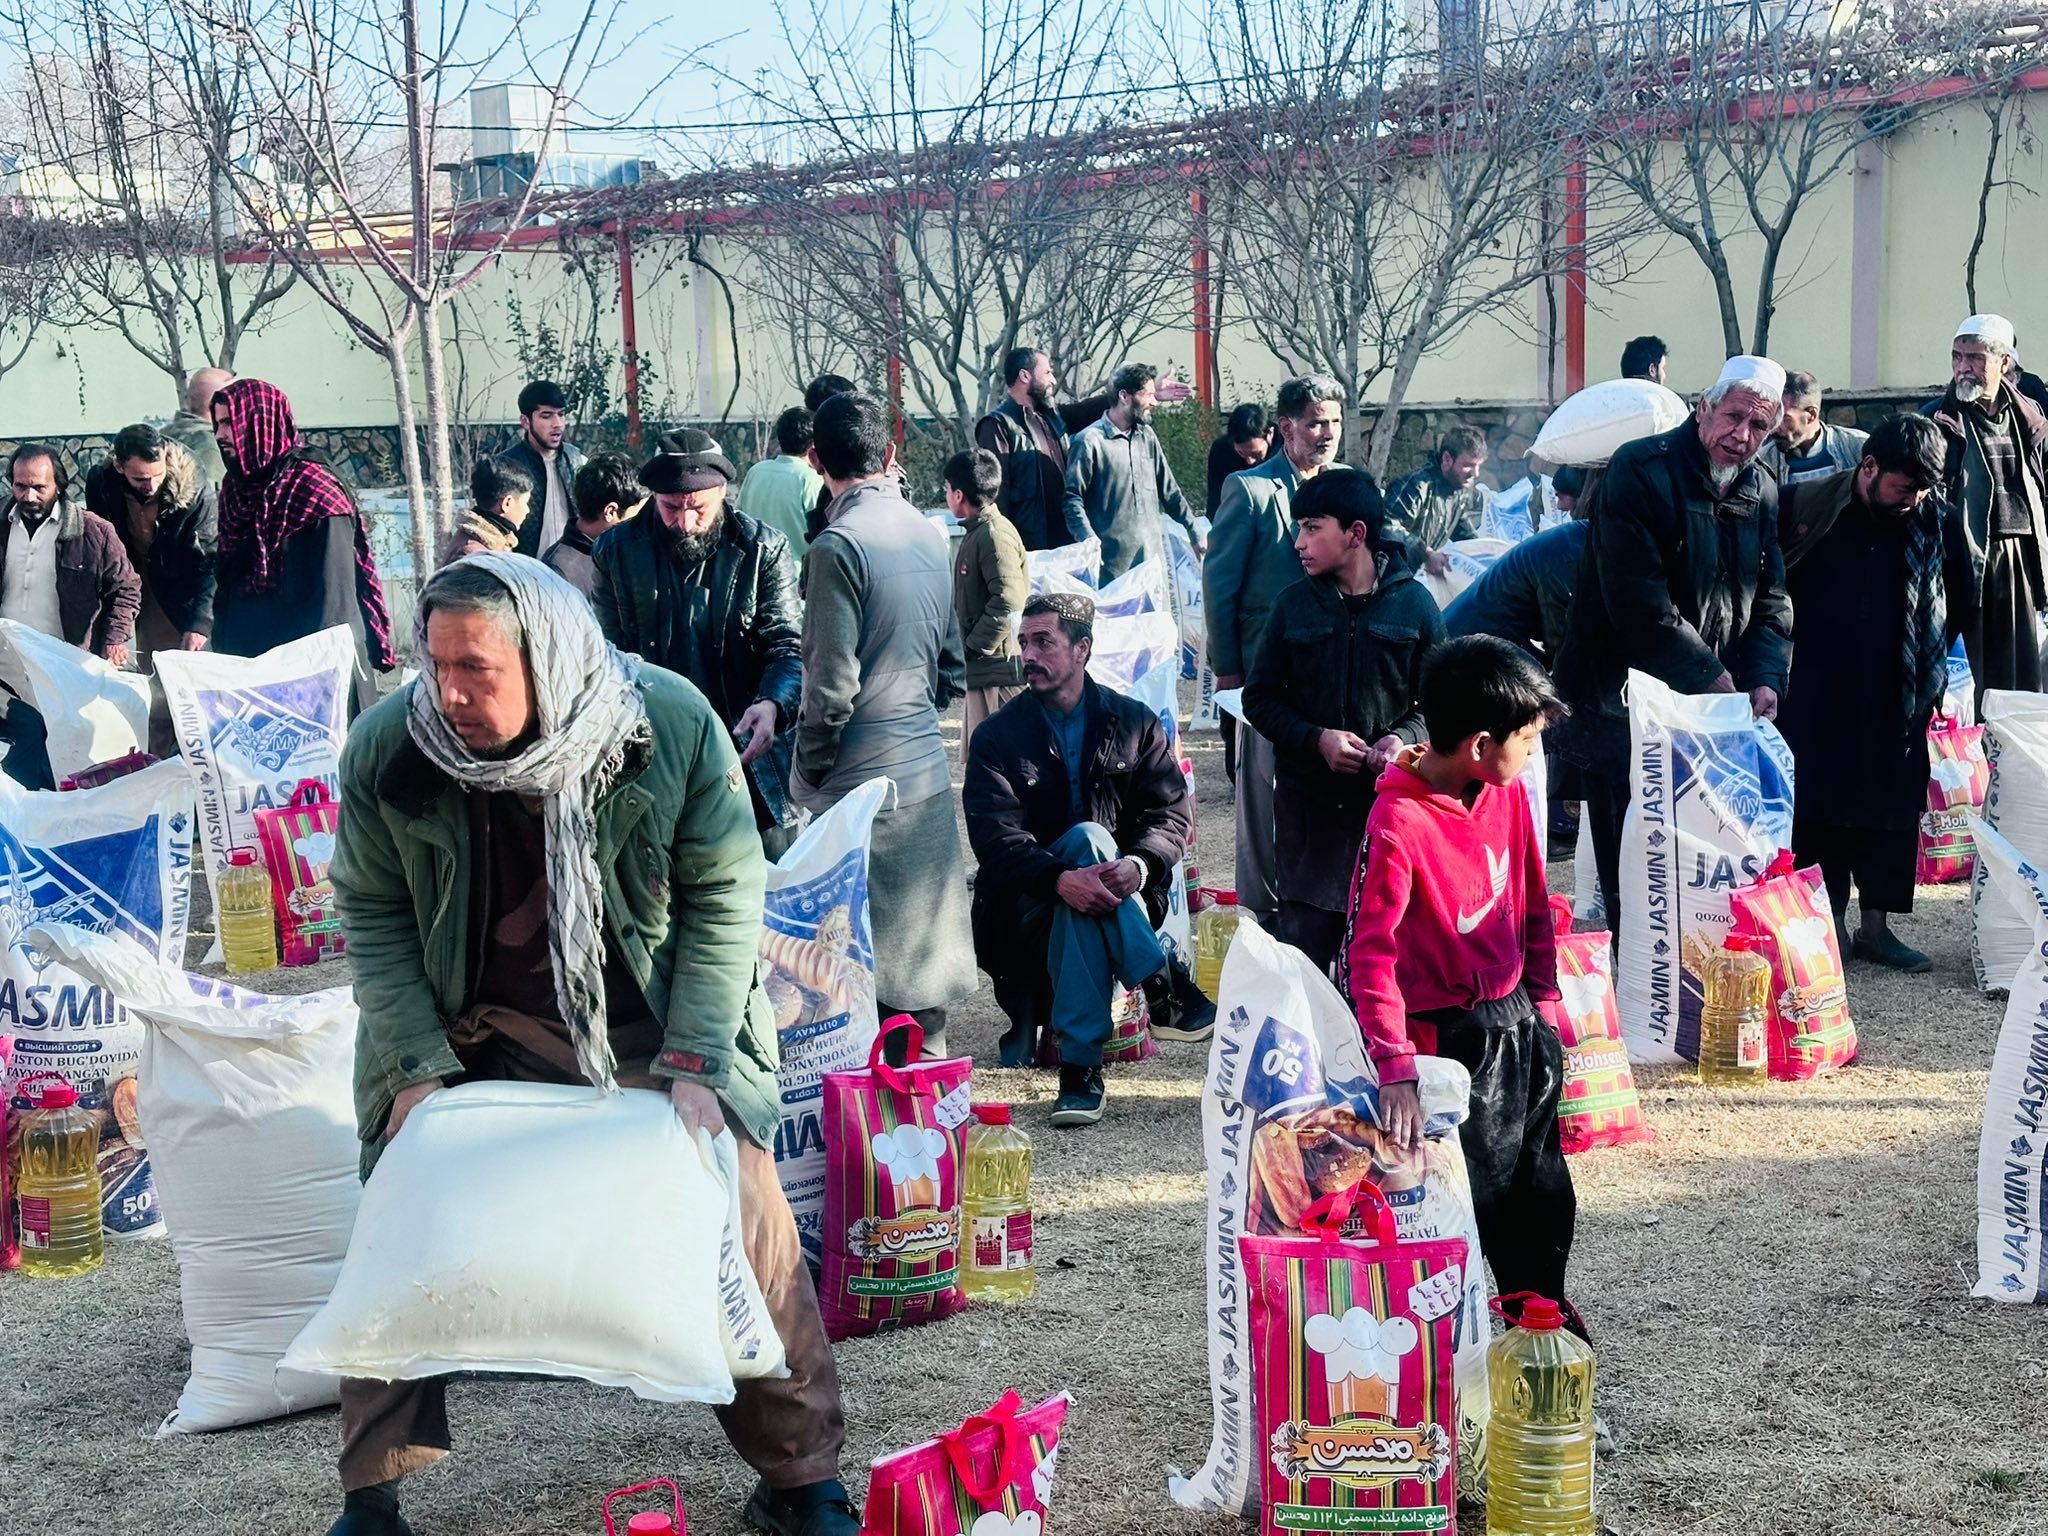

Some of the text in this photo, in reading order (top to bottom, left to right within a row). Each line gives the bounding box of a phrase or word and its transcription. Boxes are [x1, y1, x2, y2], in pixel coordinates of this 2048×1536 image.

[179, 703, 209, 768] JASMIN
[1641, 742, 1665, 826] JASMIN
[203, 789, 225, 855] JASMIN
[168, 837, 191, 938] JASMIN
[1646, 850, 1668, 936] JASMIN
[66, 1043, 90, 1052] сорт
[1567, 1051, 1622, 1073] Mohsen
[1262, 1048, 1303, 1086] 50
[122, 1192, 152, 1215] 50
[2002, 1159, 2030, 1273] JASMIN
[881, 1220, 950, 1251] محسن
[850, 1281, 880, 1290] محسن
[1217, 1206, 1238, 1348] JASMIN
[1209, 1384, 1240, 1507] JASMIN
[1312, 1437, 1413, 1468] محسن
[1276, 1509, 1311, 1521] محسن
[1338, 1513, 1377, 1528] بسمتی
[1378, 1511, 1400, 1527] بلند
[1401, 1511, 1424, 1523] دانه
